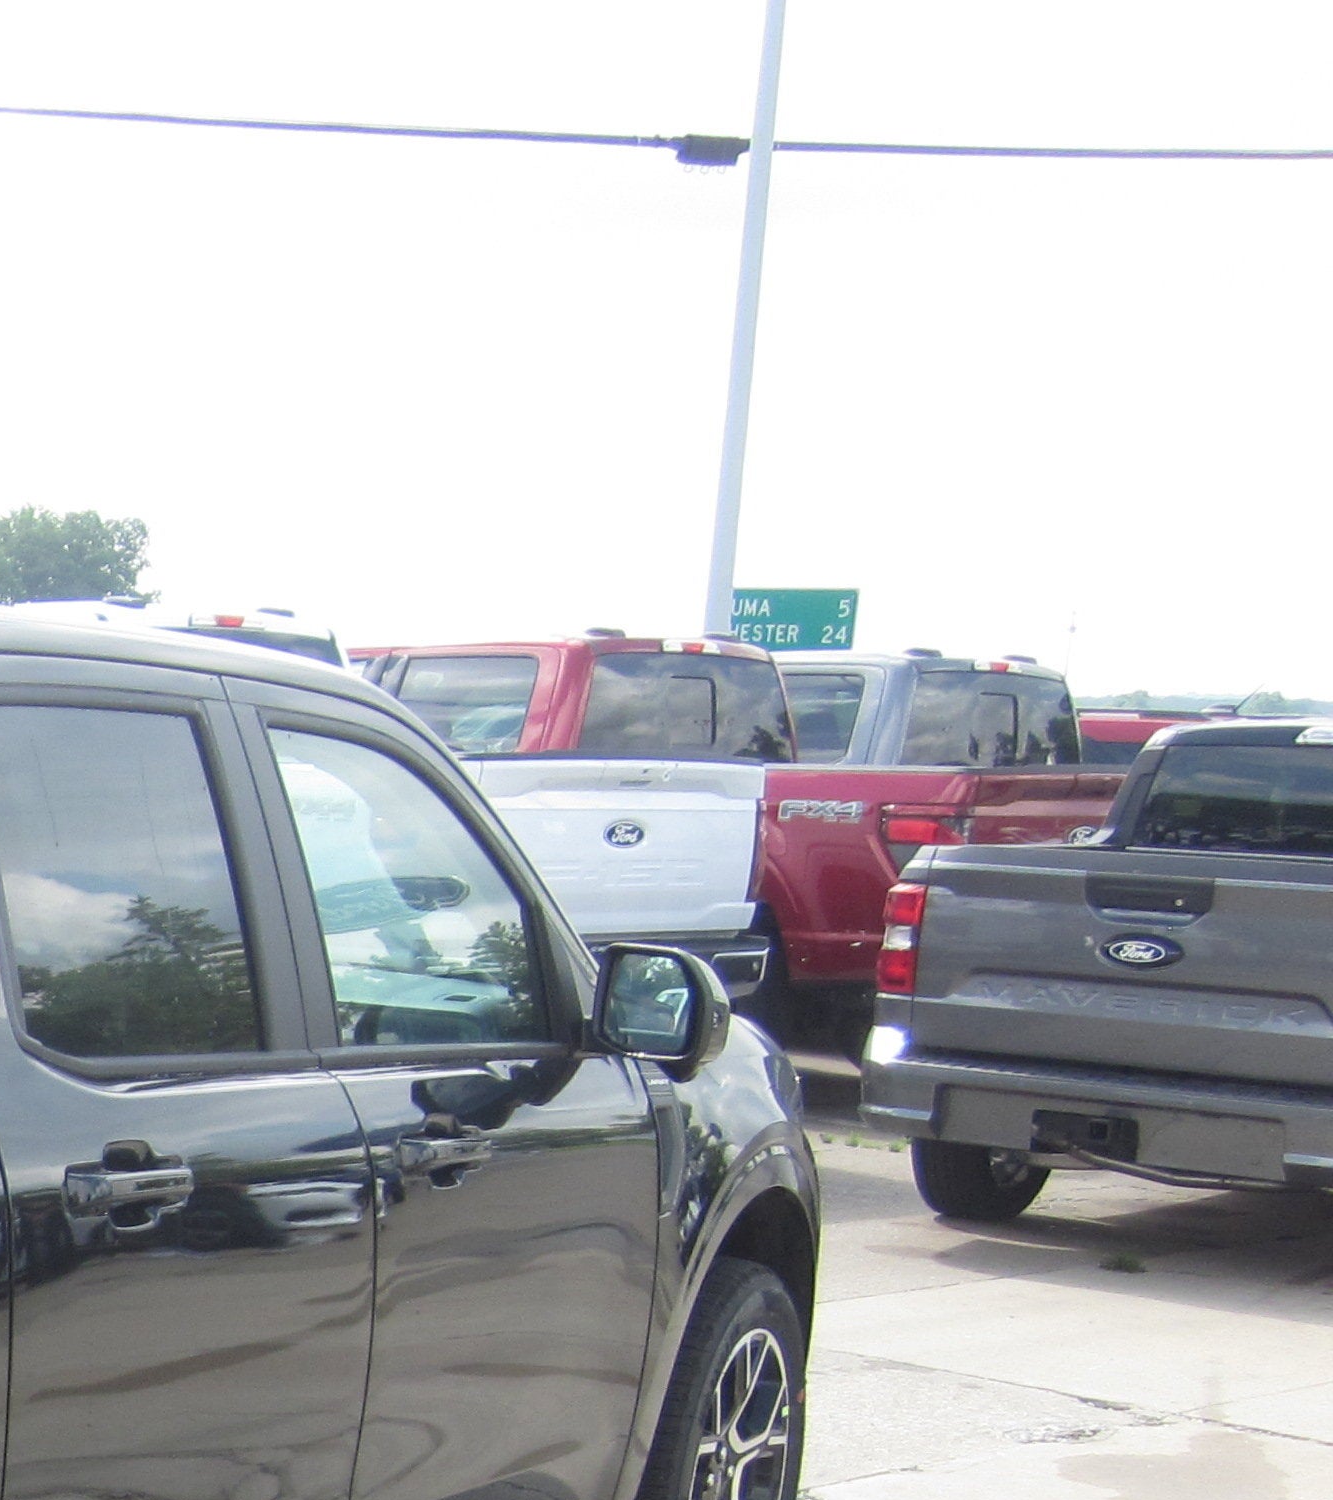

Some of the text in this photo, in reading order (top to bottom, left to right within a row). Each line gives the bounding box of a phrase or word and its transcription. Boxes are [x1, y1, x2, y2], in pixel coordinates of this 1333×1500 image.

[732, 599, 850, 618] UMA 5
[731, 624, 847, 644] HESTER 24
[778, 799, 863, 821] FX4
[979, 981, 1308, 1026] MAVERICK
